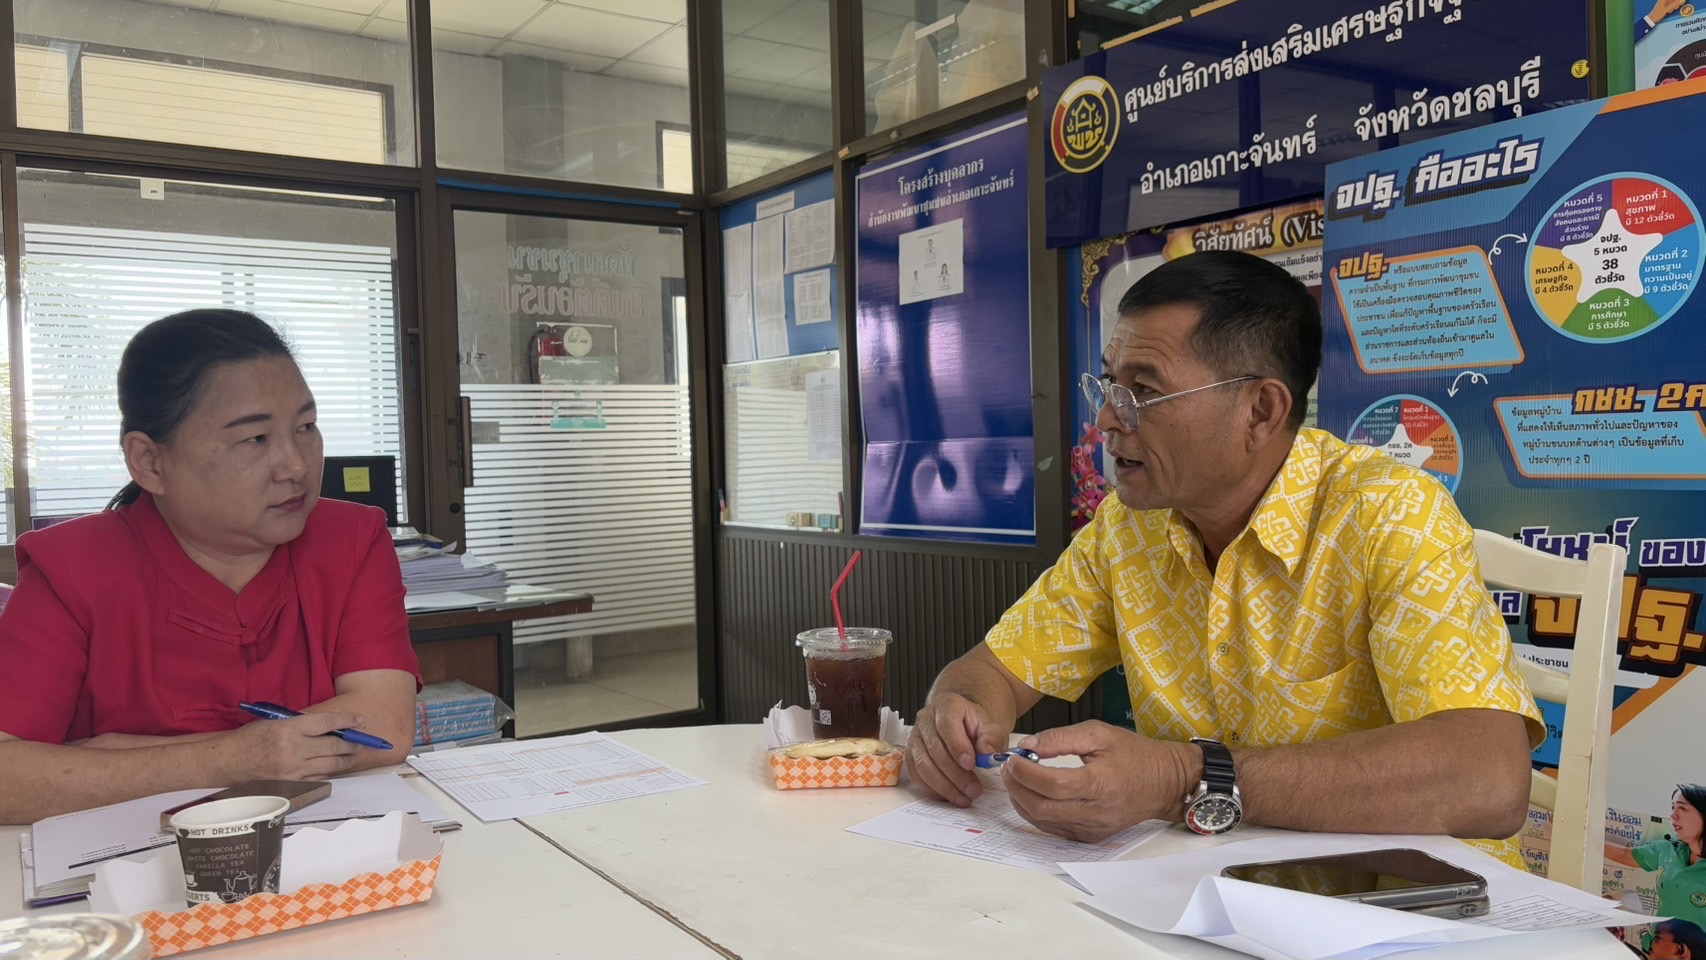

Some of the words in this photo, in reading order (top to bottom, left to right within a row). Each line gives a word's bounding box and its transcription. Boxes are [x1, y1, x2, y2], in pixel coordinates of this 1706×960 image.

[1140, 114, 1318, 195] อำเภอเกาะจันทร์
[1354, 55, 1542, 142] จังหวัดชลบุรี
[898, 158, 985, 197] โครงสร้างบุคลากร
[1335, 171, 1400, 211] จปฐ.
[1415, 140, 1541, 194] คืออะไร
[1564, 192, 1594, 207] หมวดที่
[1597, 194, 1603, 203] 5
[1625, 188, 1658, 204] หมวดที่
[1661, 189, 1668, 199] 1
[1625, 204, 1657, 217] สุขภาพ
[1634, 216, 1645, 225] 12
[1647, 210, 1675, 223] ตัวชี้วัด
[1600, 232, 1622, 243] จปฐ.
[1593, 248, 1600, 256] 5
[1602, 246, 1628, 256] หมวด
[1645, 247, 1679, 262] หมวดที่
[1681, 249, 1688, 258] 2
[1339, 252, 1388, 280] จปฐ.
[1535, 260, 1565, 275] หมวดที่
[1567, 262, 1574, 270] 4
[1602, 258, 1619, 270] 38
[1644, 262, 1682, 273] มาตรฐาน
[1595, 271, 1625, 284] ตัวชี้วัด
[1644, 270, 1693, 284] ความเป็นอยู่
[1549, 282, 1574, 293] ตัวชี้วัด
[1660, 281, 1689, 293] ตัวชี้วัด
[1589, 296, 1621, 310] หมวดที่
[1623, 298, 1630, 307] 3
[1603, 318, 1630, 330] ตัวชี้วัด
[1574, 386, 1642, 412] กชช.
[1511, 405, 1562, 419] ข้อมูลหมู่บ้าน
[1517, 418, 1678, 432] ที่แสดงให้เห็นสภาพทั่วไปและปัญหาของ
[1523, 437, 1615, 451] หมู่บ้านชนบทด้านต่างๆ
[1618, 434, 1685, 449] เป็นข้อมูลที่เก็บ
[1575, 456, 1581, 464] 2
[1583, 454, 1591, 464] ปี
[190, 828, 206, 836] HOT
[212, 825, 250, 835] DRINKS
[204, 843, 250, 854] CHOCOLATE
[210, 850, 254, 861] CHOCOLATE
[231, 859, 245, 867] TEA
